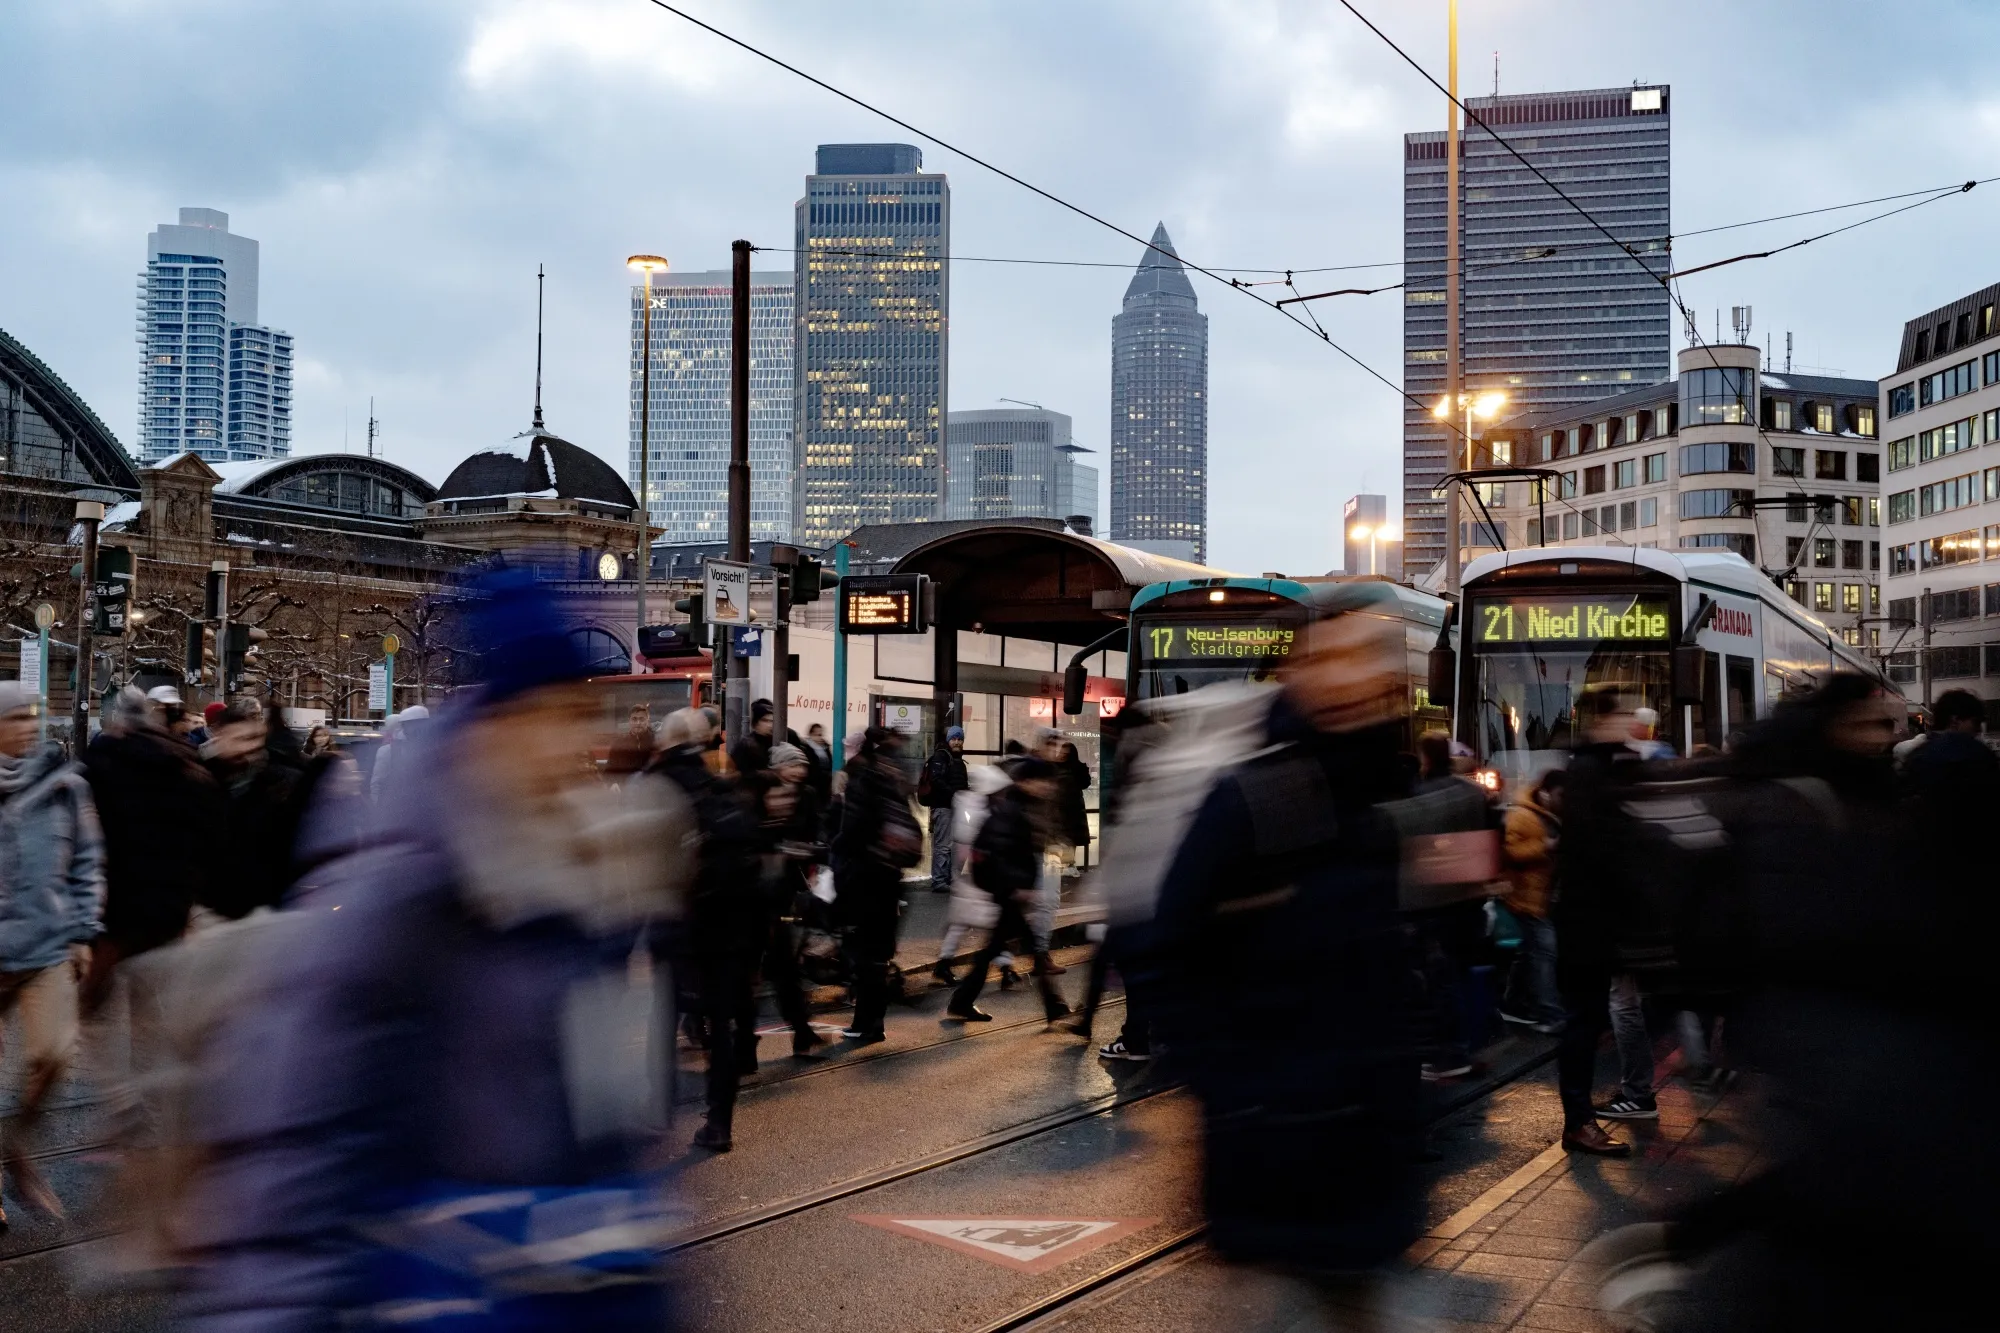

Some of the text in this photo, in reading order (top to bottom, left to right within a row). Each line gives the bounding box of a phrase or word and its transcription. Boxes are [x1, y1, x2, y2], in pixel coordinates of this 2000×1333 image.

[710, 568, 745, 584] Vorsicht!
[1484, 604, 1666, 640] 21 Nied Kirche
[1149, 627, 1294, 658] 17 Neu-Isenburg
[1191, 642, 1289, 658] Stadtgrenze
[857, 700, 867, 713] in
